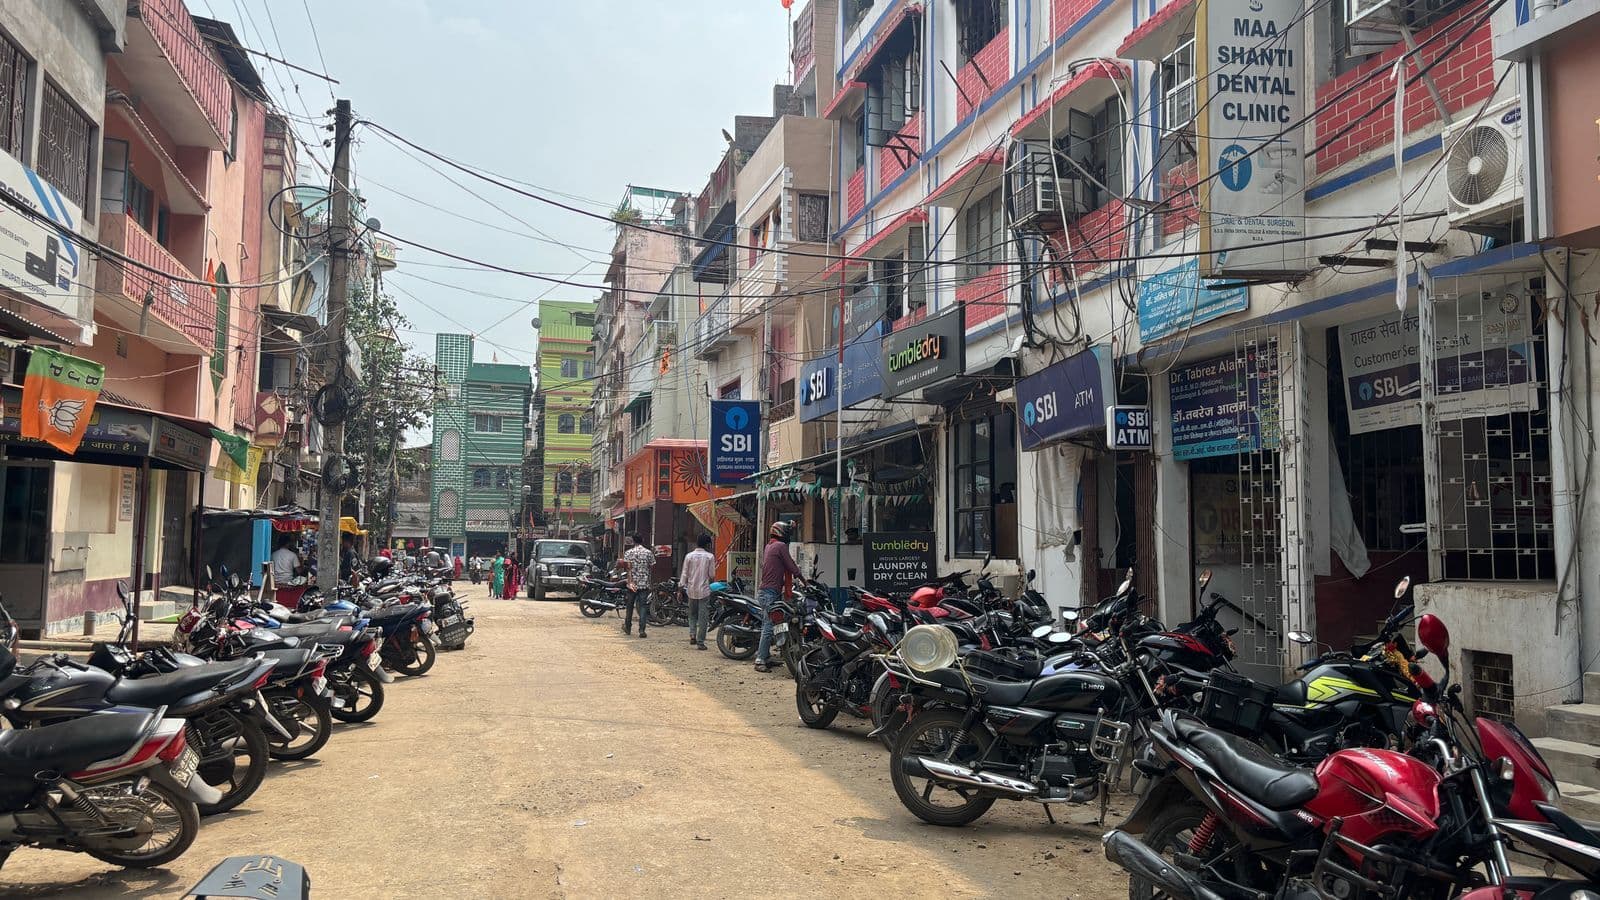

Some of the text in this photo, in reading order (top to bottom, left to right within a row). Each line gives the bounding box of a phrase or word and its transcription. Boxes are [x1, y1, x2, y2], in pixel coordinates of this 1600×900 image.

[1234, 18, 1278, 38] MAA
[1217, 45, 1293, 67] SHANTI
[1217, 74, 1295, 95] DENTAL
[1222, 102, 1290, 123] CLINIC
[810, 367, 828, 401] SBI
[1170, 372, 1183, 383] Dr.
[1185, 365, 1217, 380] Tabrez
[1373, 375, 1400, 400] SBI
[1035, 387, 1094, 423] SBI ATM
[1127, 411, 1149, 427] SBI
[721, 433, 752, 452] SBI
[1116, 428, 1150, 445] ATM
[872, 561, 928, 570] LAUNDRY &
[873, 571, 928, 580] DRY CLEAN
